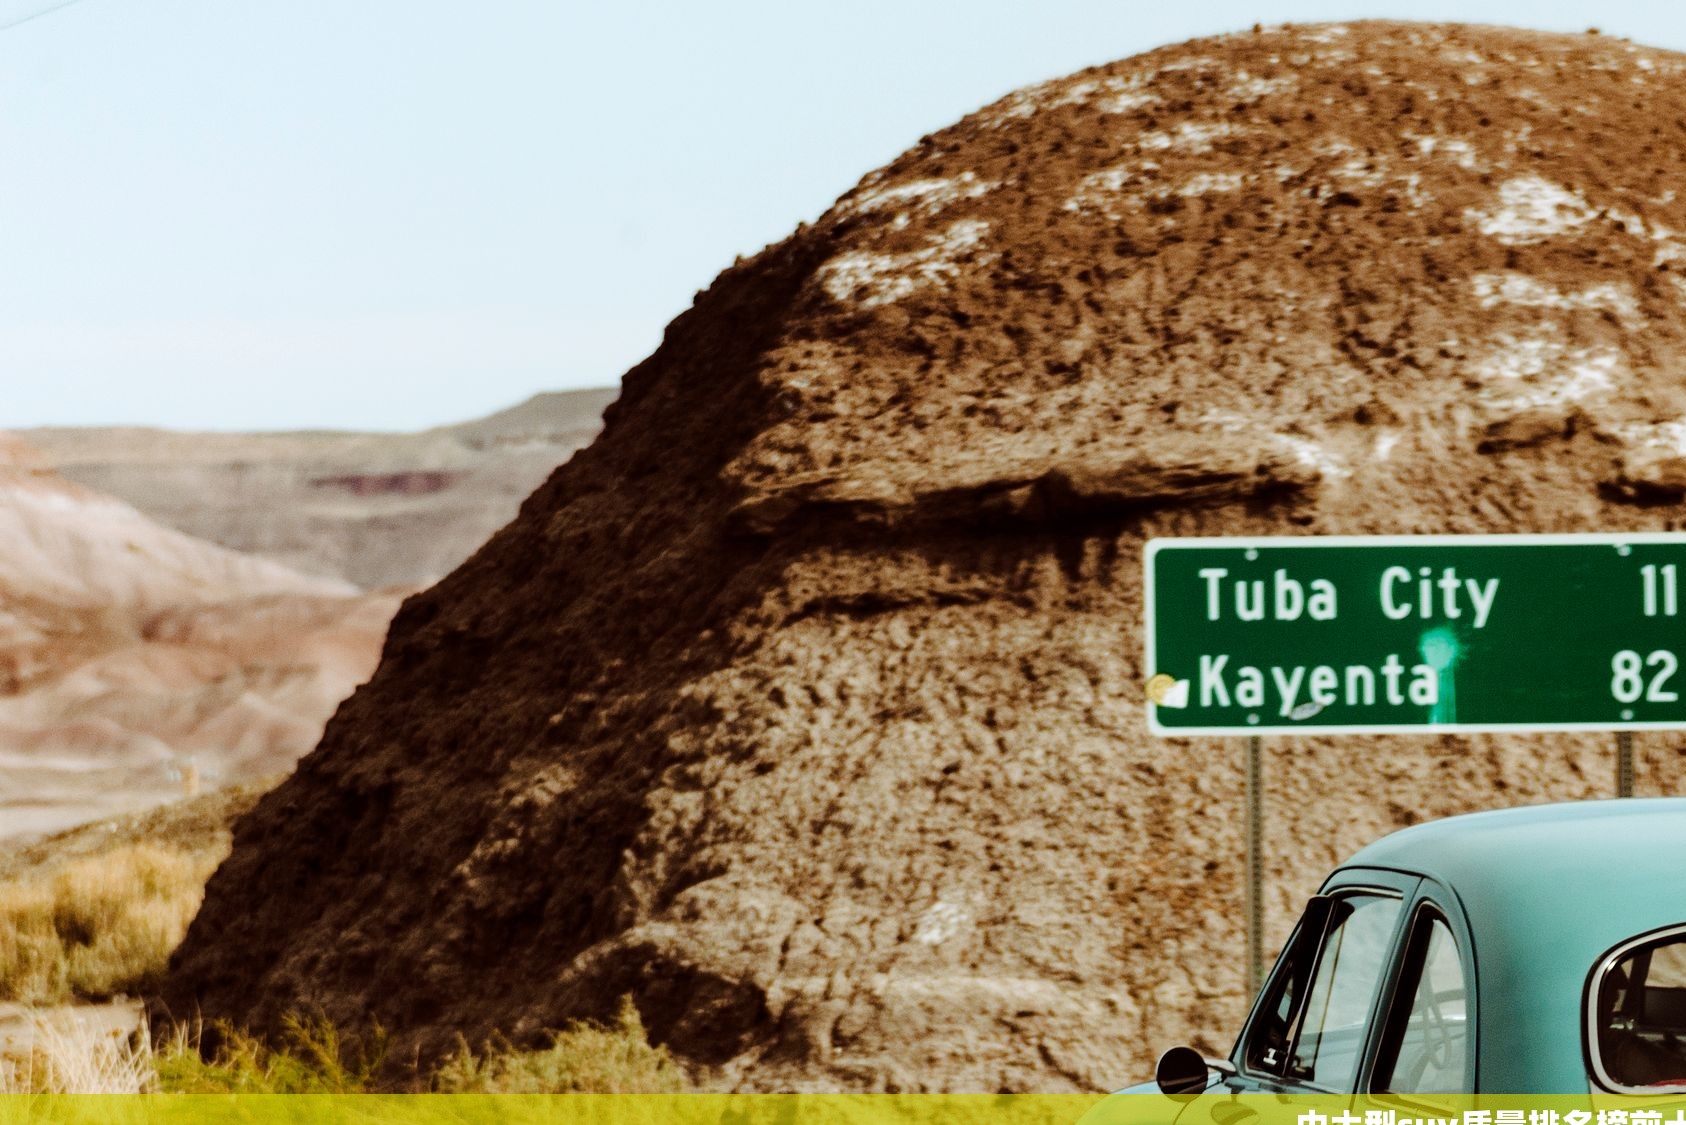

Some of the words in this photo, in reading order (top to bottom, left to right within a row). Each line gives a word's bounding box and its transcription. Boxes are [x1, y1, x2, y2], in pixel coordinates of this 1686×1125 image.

[1199, 568, 1337, 621] Tuba
[1380, 566, 1500, 628] City
[1640, 564, 1678, 616] 11
[1200, 654, 1440, 717] Kayenta
[1610, 649, 1679, 703] 82
